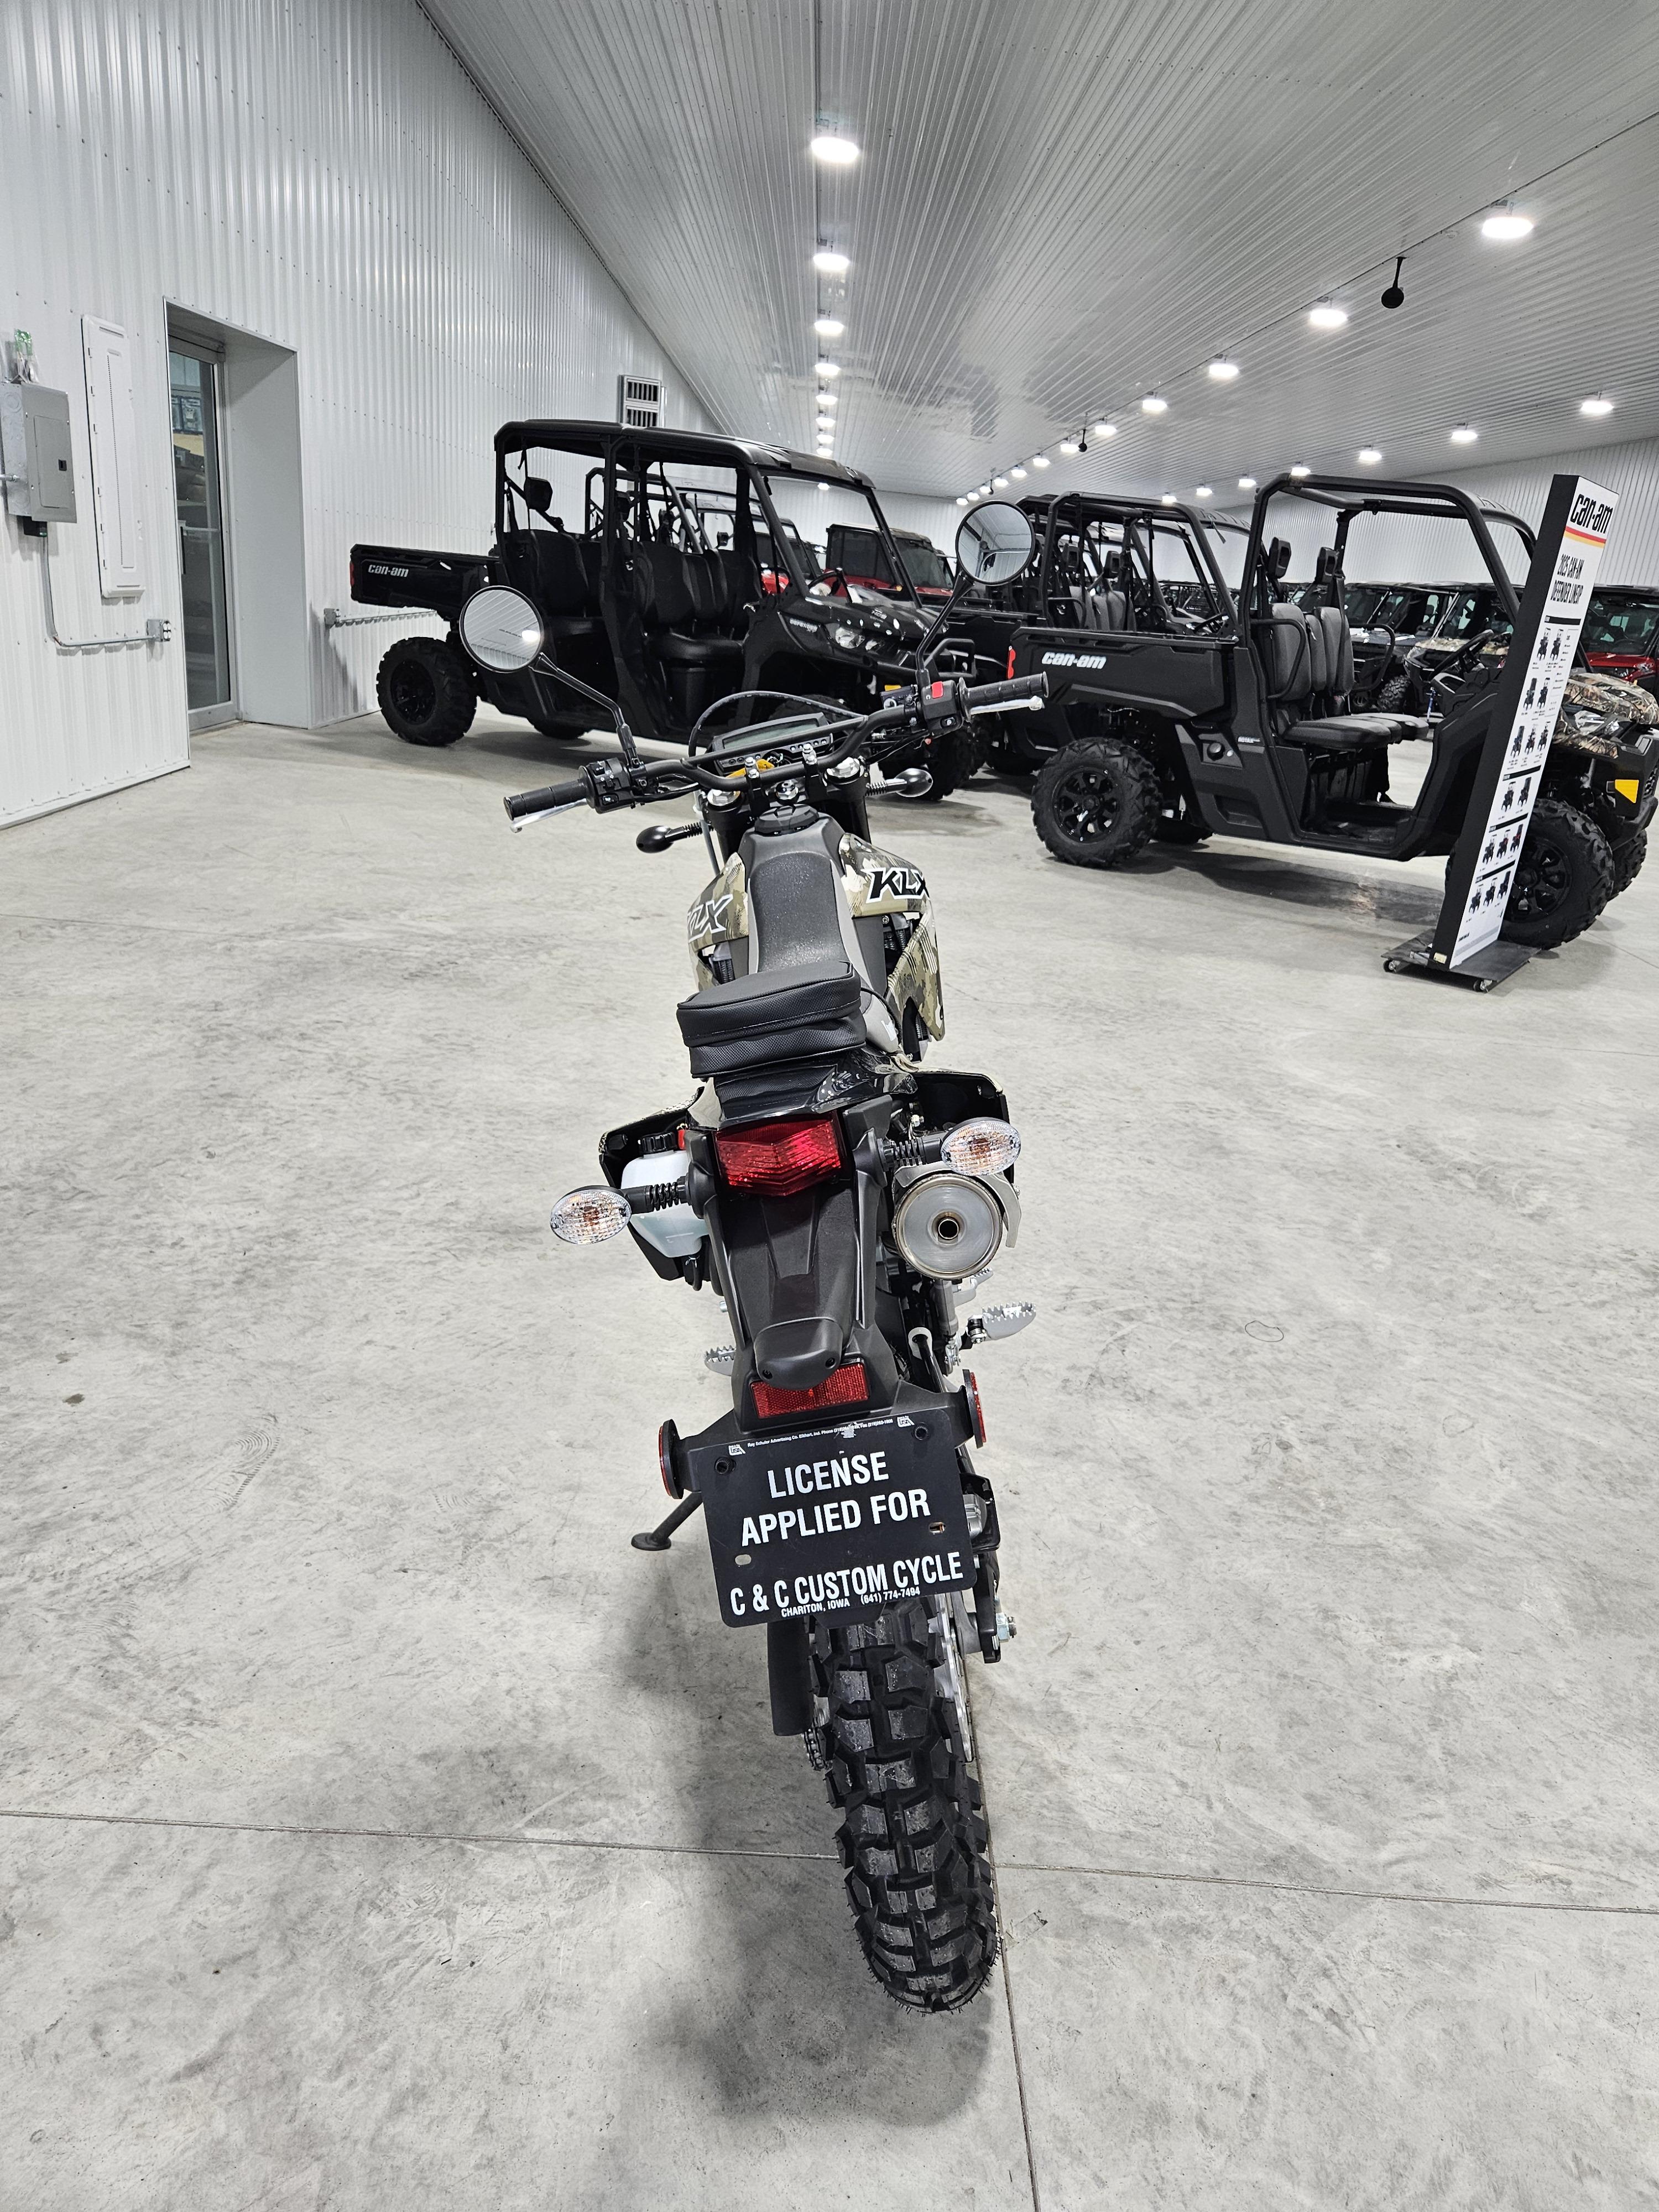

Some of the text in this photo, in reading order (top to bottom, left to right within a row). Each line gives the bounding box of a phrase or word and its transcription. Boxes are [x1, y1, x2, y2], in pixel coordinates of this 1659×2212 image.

[1570, 494, 1613, 534] can-am
[368, 565, 409, 577] can-am
[1042, 652, 1107, 669] can-am
[860, 867, 930, 904] KLX
[687, 894, 733, 943] LX
[768, 1451, 889, 1498] LICENSE
[742, 1489, 931, 1546] APPLIED FOR
[731, 1552, 963, 1615] C & C CUSTOM CYCLE
[781, 1586, 921, 1618] CHARITON, IOWA (641) 774-7494
